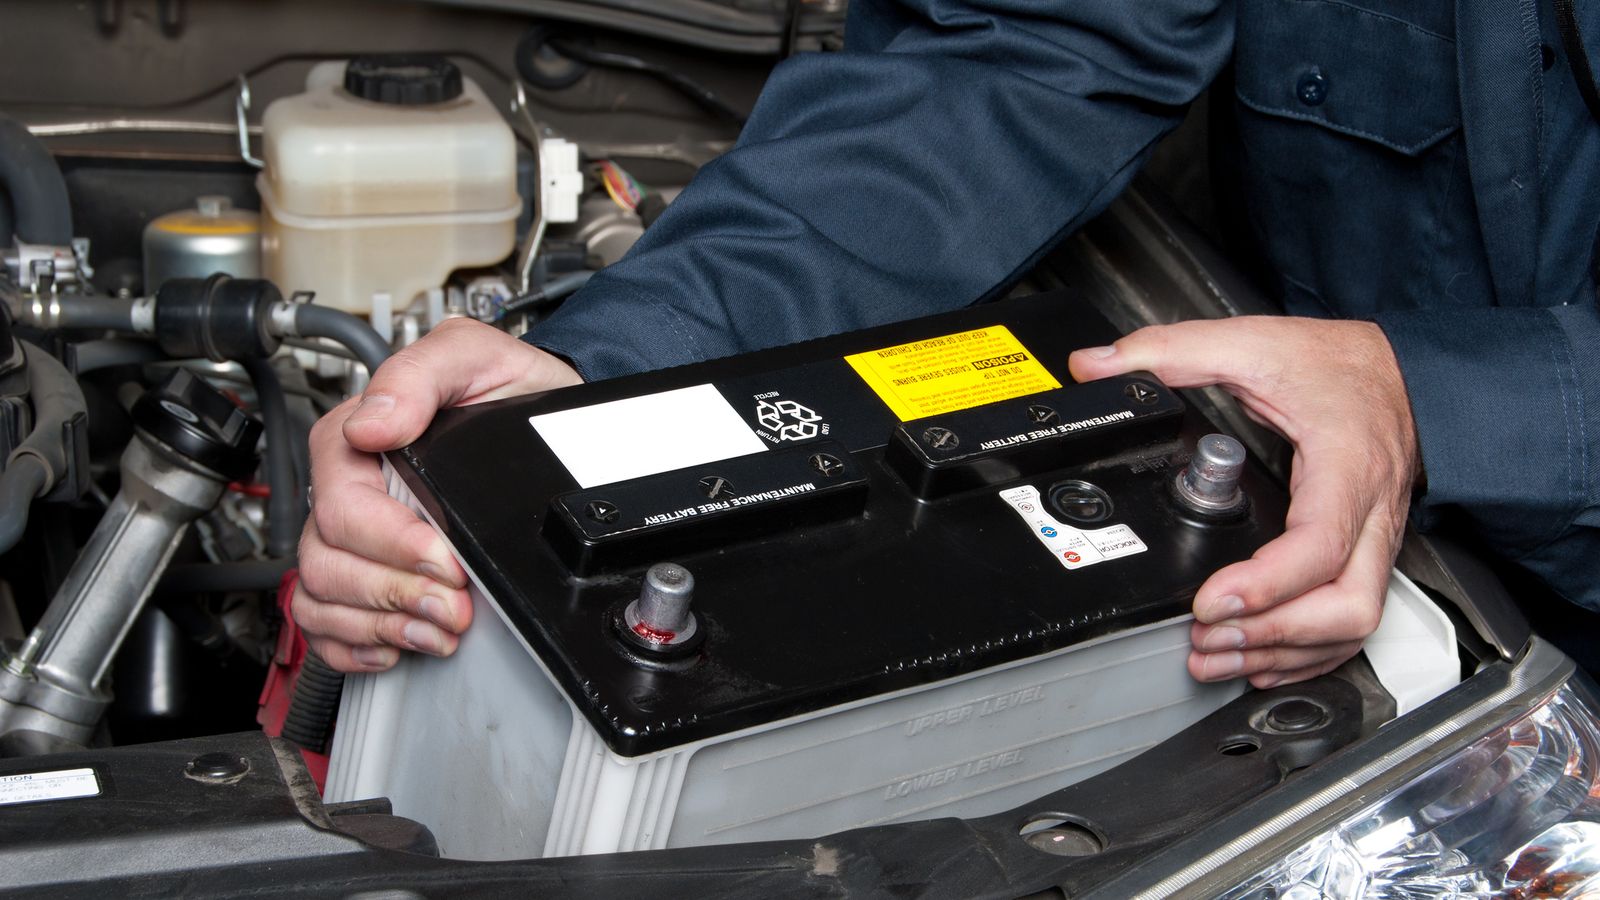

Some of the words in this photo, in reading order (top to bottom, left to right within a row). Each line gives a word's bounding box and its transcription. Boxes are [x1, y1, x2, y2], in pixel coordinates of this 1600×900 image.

[956, 334, 970, 342] OUT
[972, 331, 987, 339] KEEP
[912, 343, 922, 351] OF
[923, 339, 945, 349] REACH
[877, 345, 911, 358] CHILDREN
[974, 355, 1017, 368] POISON
[917, 370, 943, 381] SEVERE
[943, 365, 971, 375] CAUSES
[984, 371, 995, 379] TIP
[996, 368, 1010, 377] NOT
[892, 376, 917, 386] BURNS
[753, 391, 780, 400] RECYCLE
[1058, 410, 1134, 432] MAINTENANCE
[821, 423, 830, 435] LEAD
[1028, 426, 1056, 440] FREE
[756, 429, 780, 444] RETURN
[980, 433, 1026, 450] BATTERY
[731, 482, 815, 505] MAINTENANCE
[697, 499, 729, 514] FREE
[644, 507, 695, 525] BATTERY
[1098, 540, 1138, 552] INDICATOR
[904, 705, 973, 737] UPPER
[980, 685, 1046, 717] LEVEL
[884, 767, 957, 801] LOWER
[964, 749, 1024, 778] LEVEL
